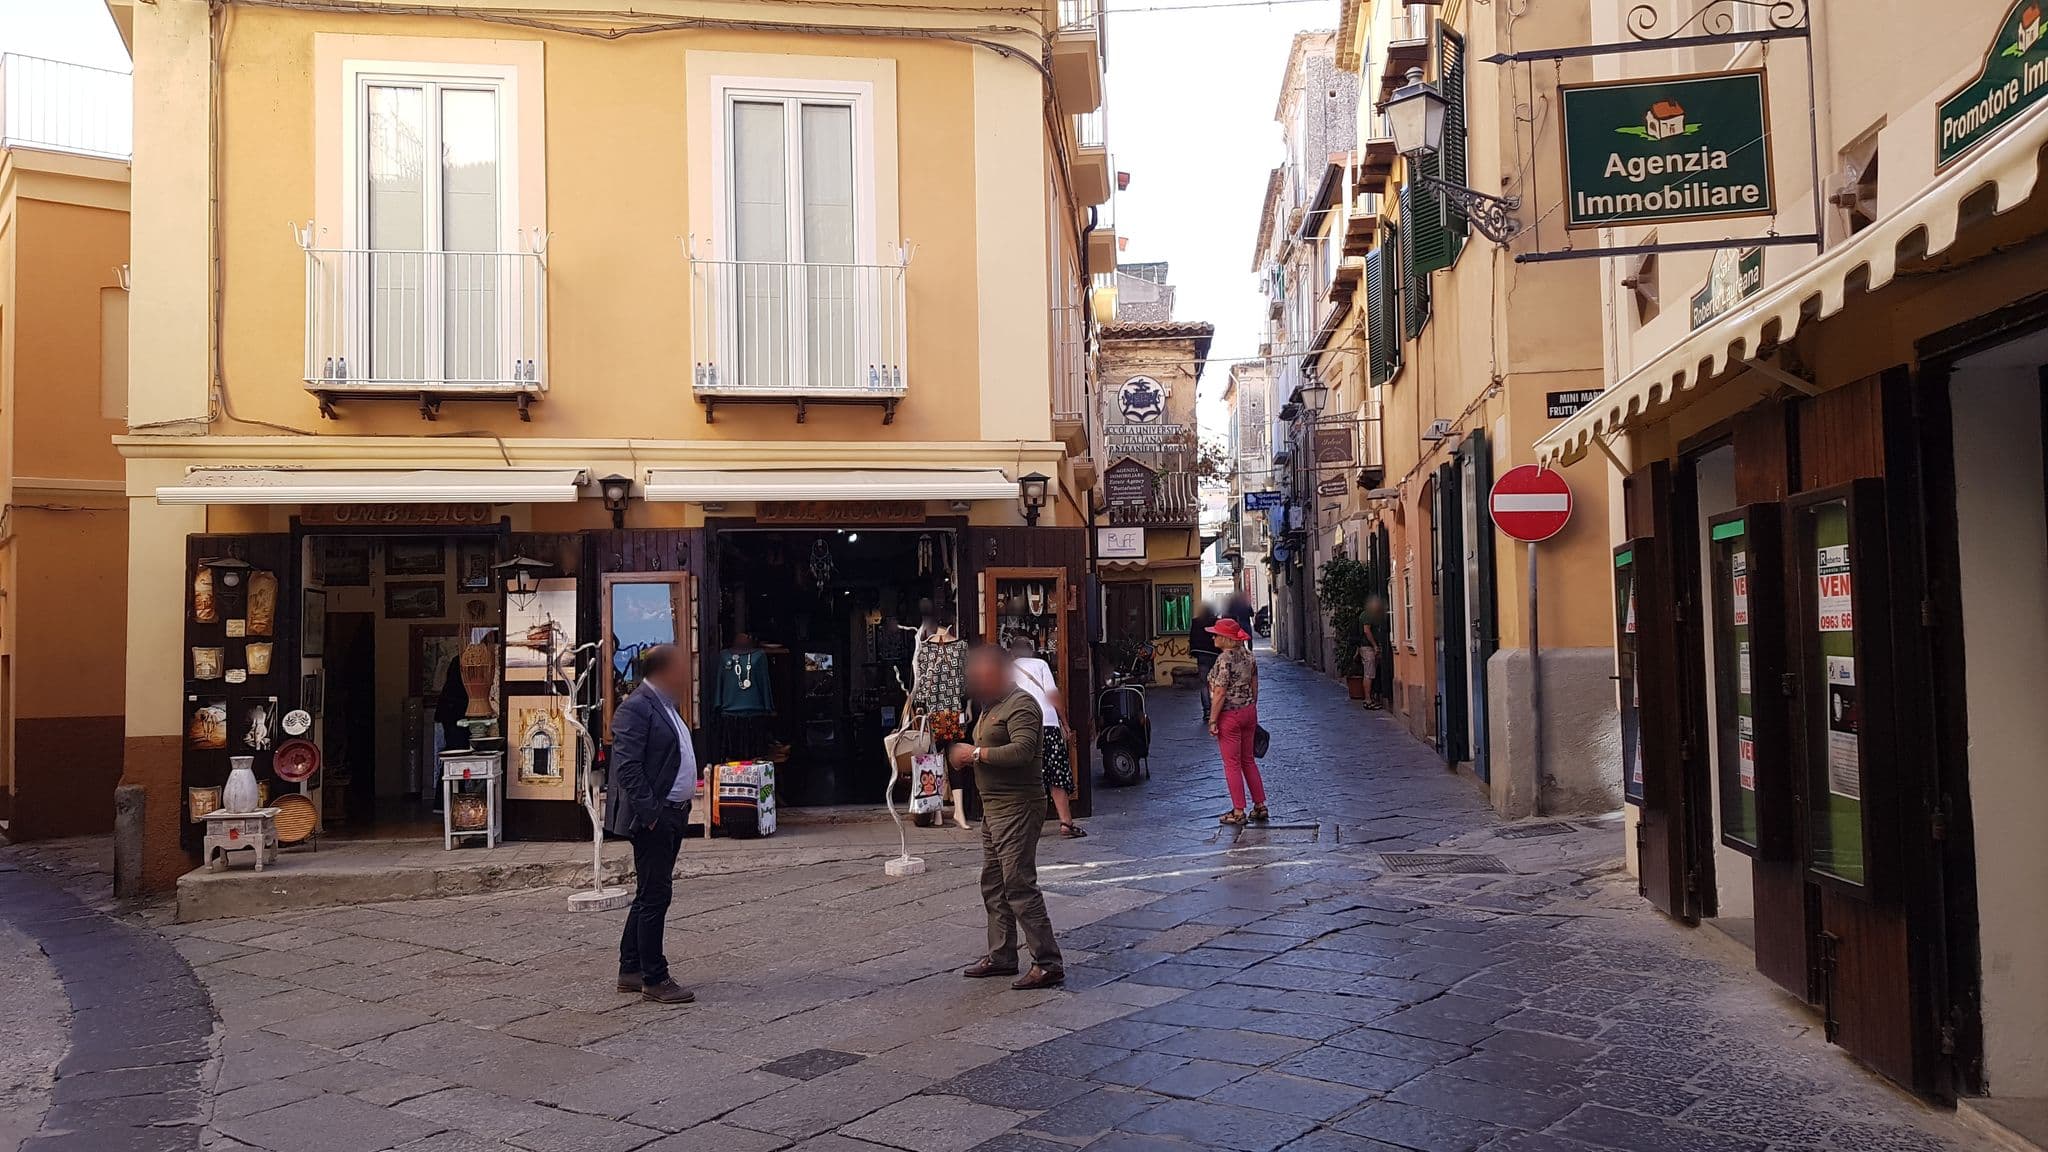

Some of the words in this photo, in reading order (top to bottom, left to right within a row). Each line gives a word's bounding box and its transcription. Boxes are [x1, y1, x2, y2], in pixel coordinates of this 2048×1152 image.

[1943, 78, 2019, 150] Promotore
[2023, 57, 2048, 96] Im
[1604, 146, 1728, 182] Agenzia
[1577, 182, 1760, 216] Immobiliare
[1693, 294, 1720, 329] Roberto
[1721, 265, 1759, 305] Laureana
[1559, 394, 1579, 403] MINI
[1549, 405, 1578, 416] FRUTTA
[1124, 435, 1162, 444] ITALIANA
[1820, 575, 1850, 597] VEN
[1820, 615, 1839, 629] 0963
